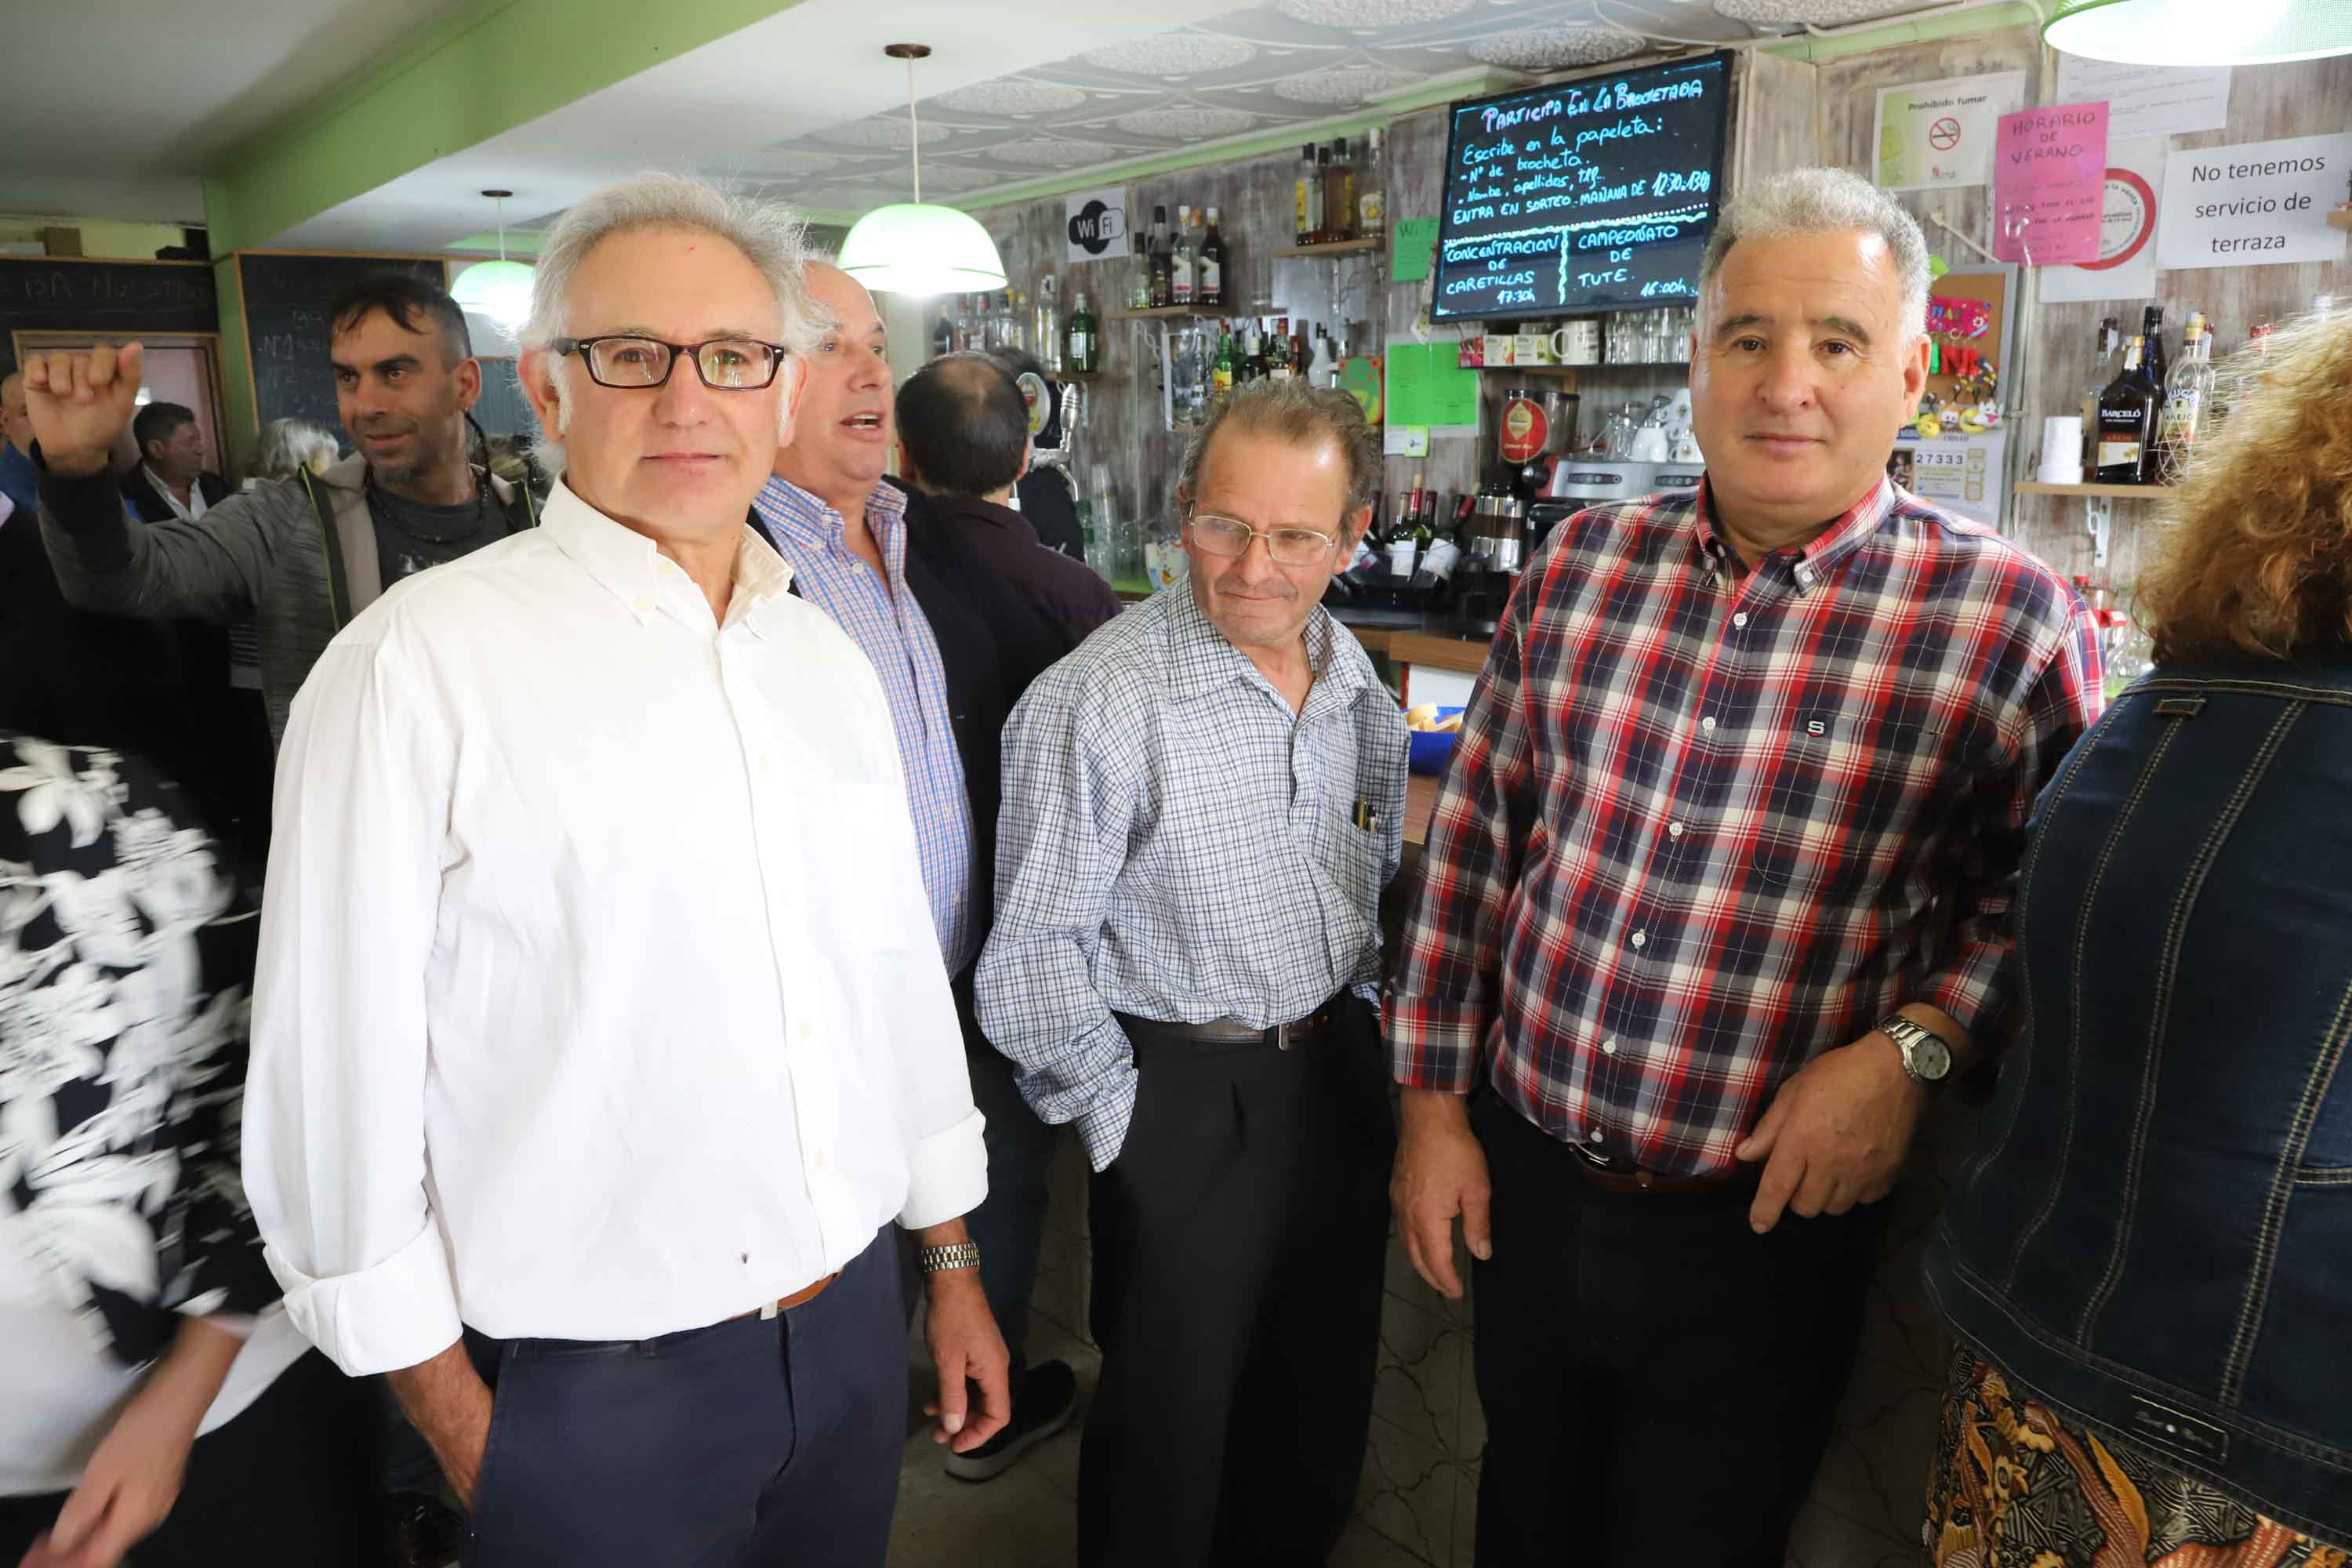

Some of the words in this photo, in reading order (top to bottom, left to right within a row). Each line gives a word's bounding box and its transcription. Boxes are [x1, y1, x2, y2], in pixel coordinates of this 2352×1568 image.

[1480, 100, 1563, 133] PARTICIPA
[1567, 91, 1591, 118] EN
[1593, 86, 1612, 113] LA
[1908, 100, 1955, 111] Prohibido
[1958, 95, 1987, 106] fumar
[2013, 112, 2096, 136] HORARIO
[1462, 137, 1515, 165] Escribe
[1550, 125, 1566, 147] la
[1575, 115, 1663, 152] papeleta:
[2040, 131, 2059, 143] DE
[2010, 143, 2083, 164] VERANO
[1489, 164, 1504, 177] de
[2192, 164, 2221, 183] No
[2228, 156, 2326, 180] tenemos
[1453, 205, 1495, 226] ENTRA
[1500, 202, 1519, 216] EN
[1579, 185, 1628, 206] MAÑANA
[1631, 180, 1647, 197] DE
[2195, 195, 2277, 219] servicio
[2283, 192, 2312, 212] de
[1578, 224, 1679, 249] CAMPEONATO
[2211, 234, 2285, 253] terraza
[1446, 234, 1560, 262] CONCENTRACION
[1610, 247, 1633, 263] DE
[1487, 258, 1508, 271] DE
[1446, 270, 1536, 295] CARETILLAS
[1497, 287, 1536, 305] 17:30h
[2101, 408, 2141, 419] BARCELÓ
[1916, 454, 1963, 465] 27333
